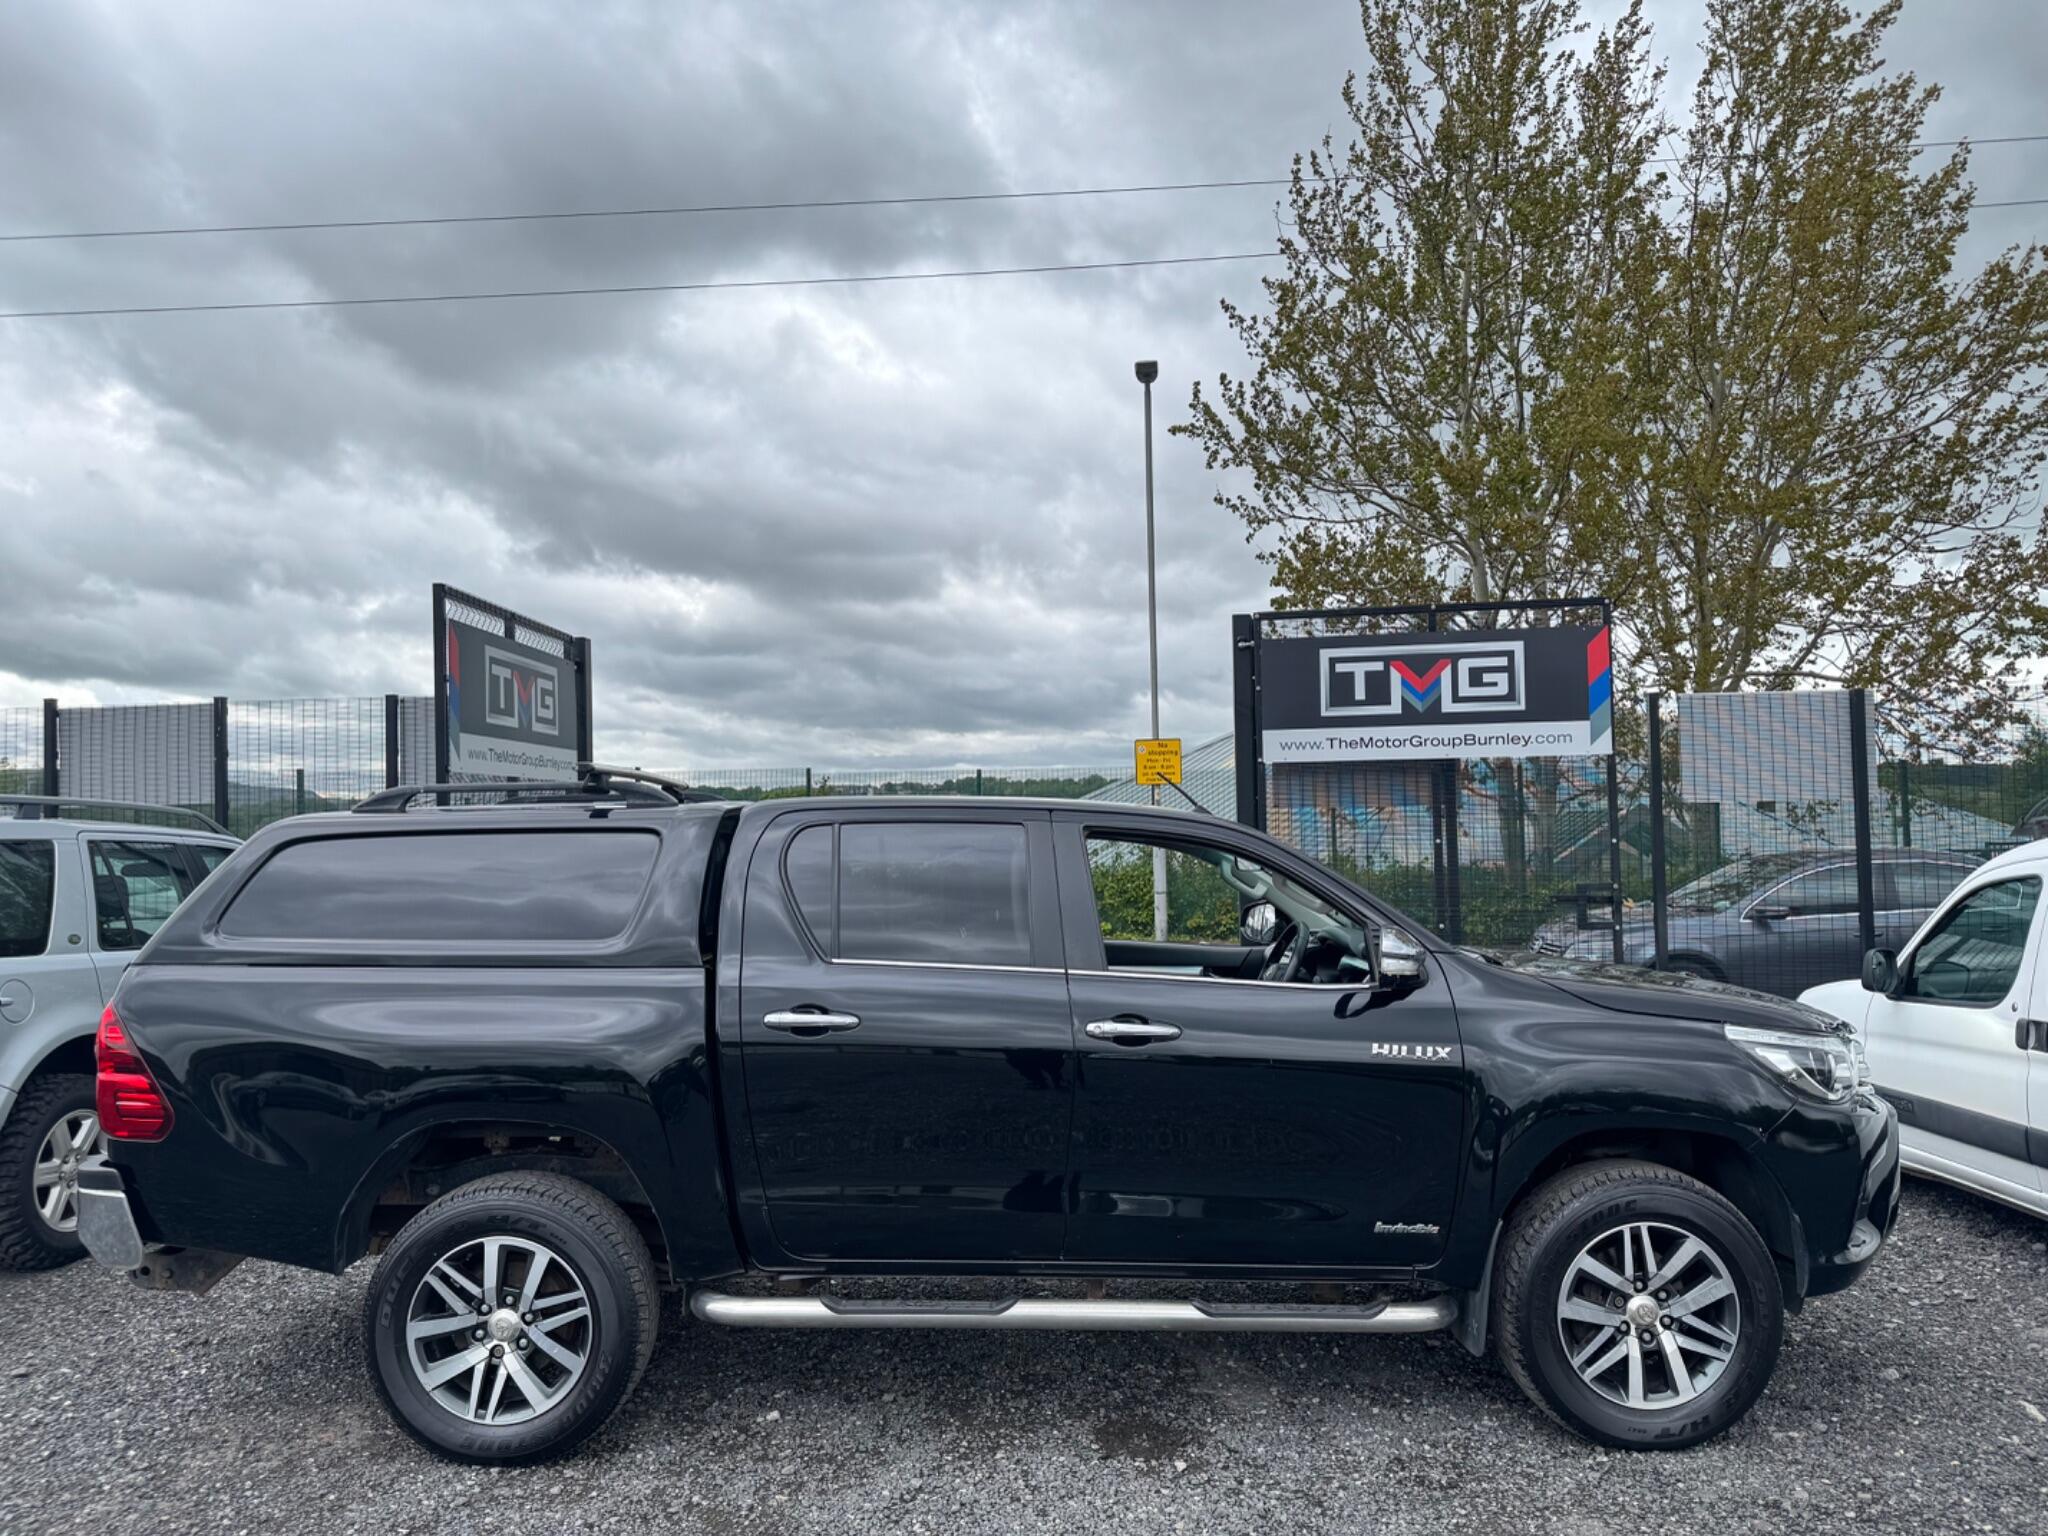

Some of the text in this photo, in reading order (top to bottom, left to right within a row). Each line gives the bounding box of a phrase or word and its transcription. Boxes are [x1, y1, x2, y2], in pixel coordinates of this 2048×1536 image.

[1334, 656, 1510, 714] TMG
[490, 662, 553, 729] TMG
[1279, 731, 1574, 751] www.TheMotorGroupBurnley.com
[1372, 1043, 1452, 1057] HILUX
[1374, 1221, 1440, 1234] Invincible
